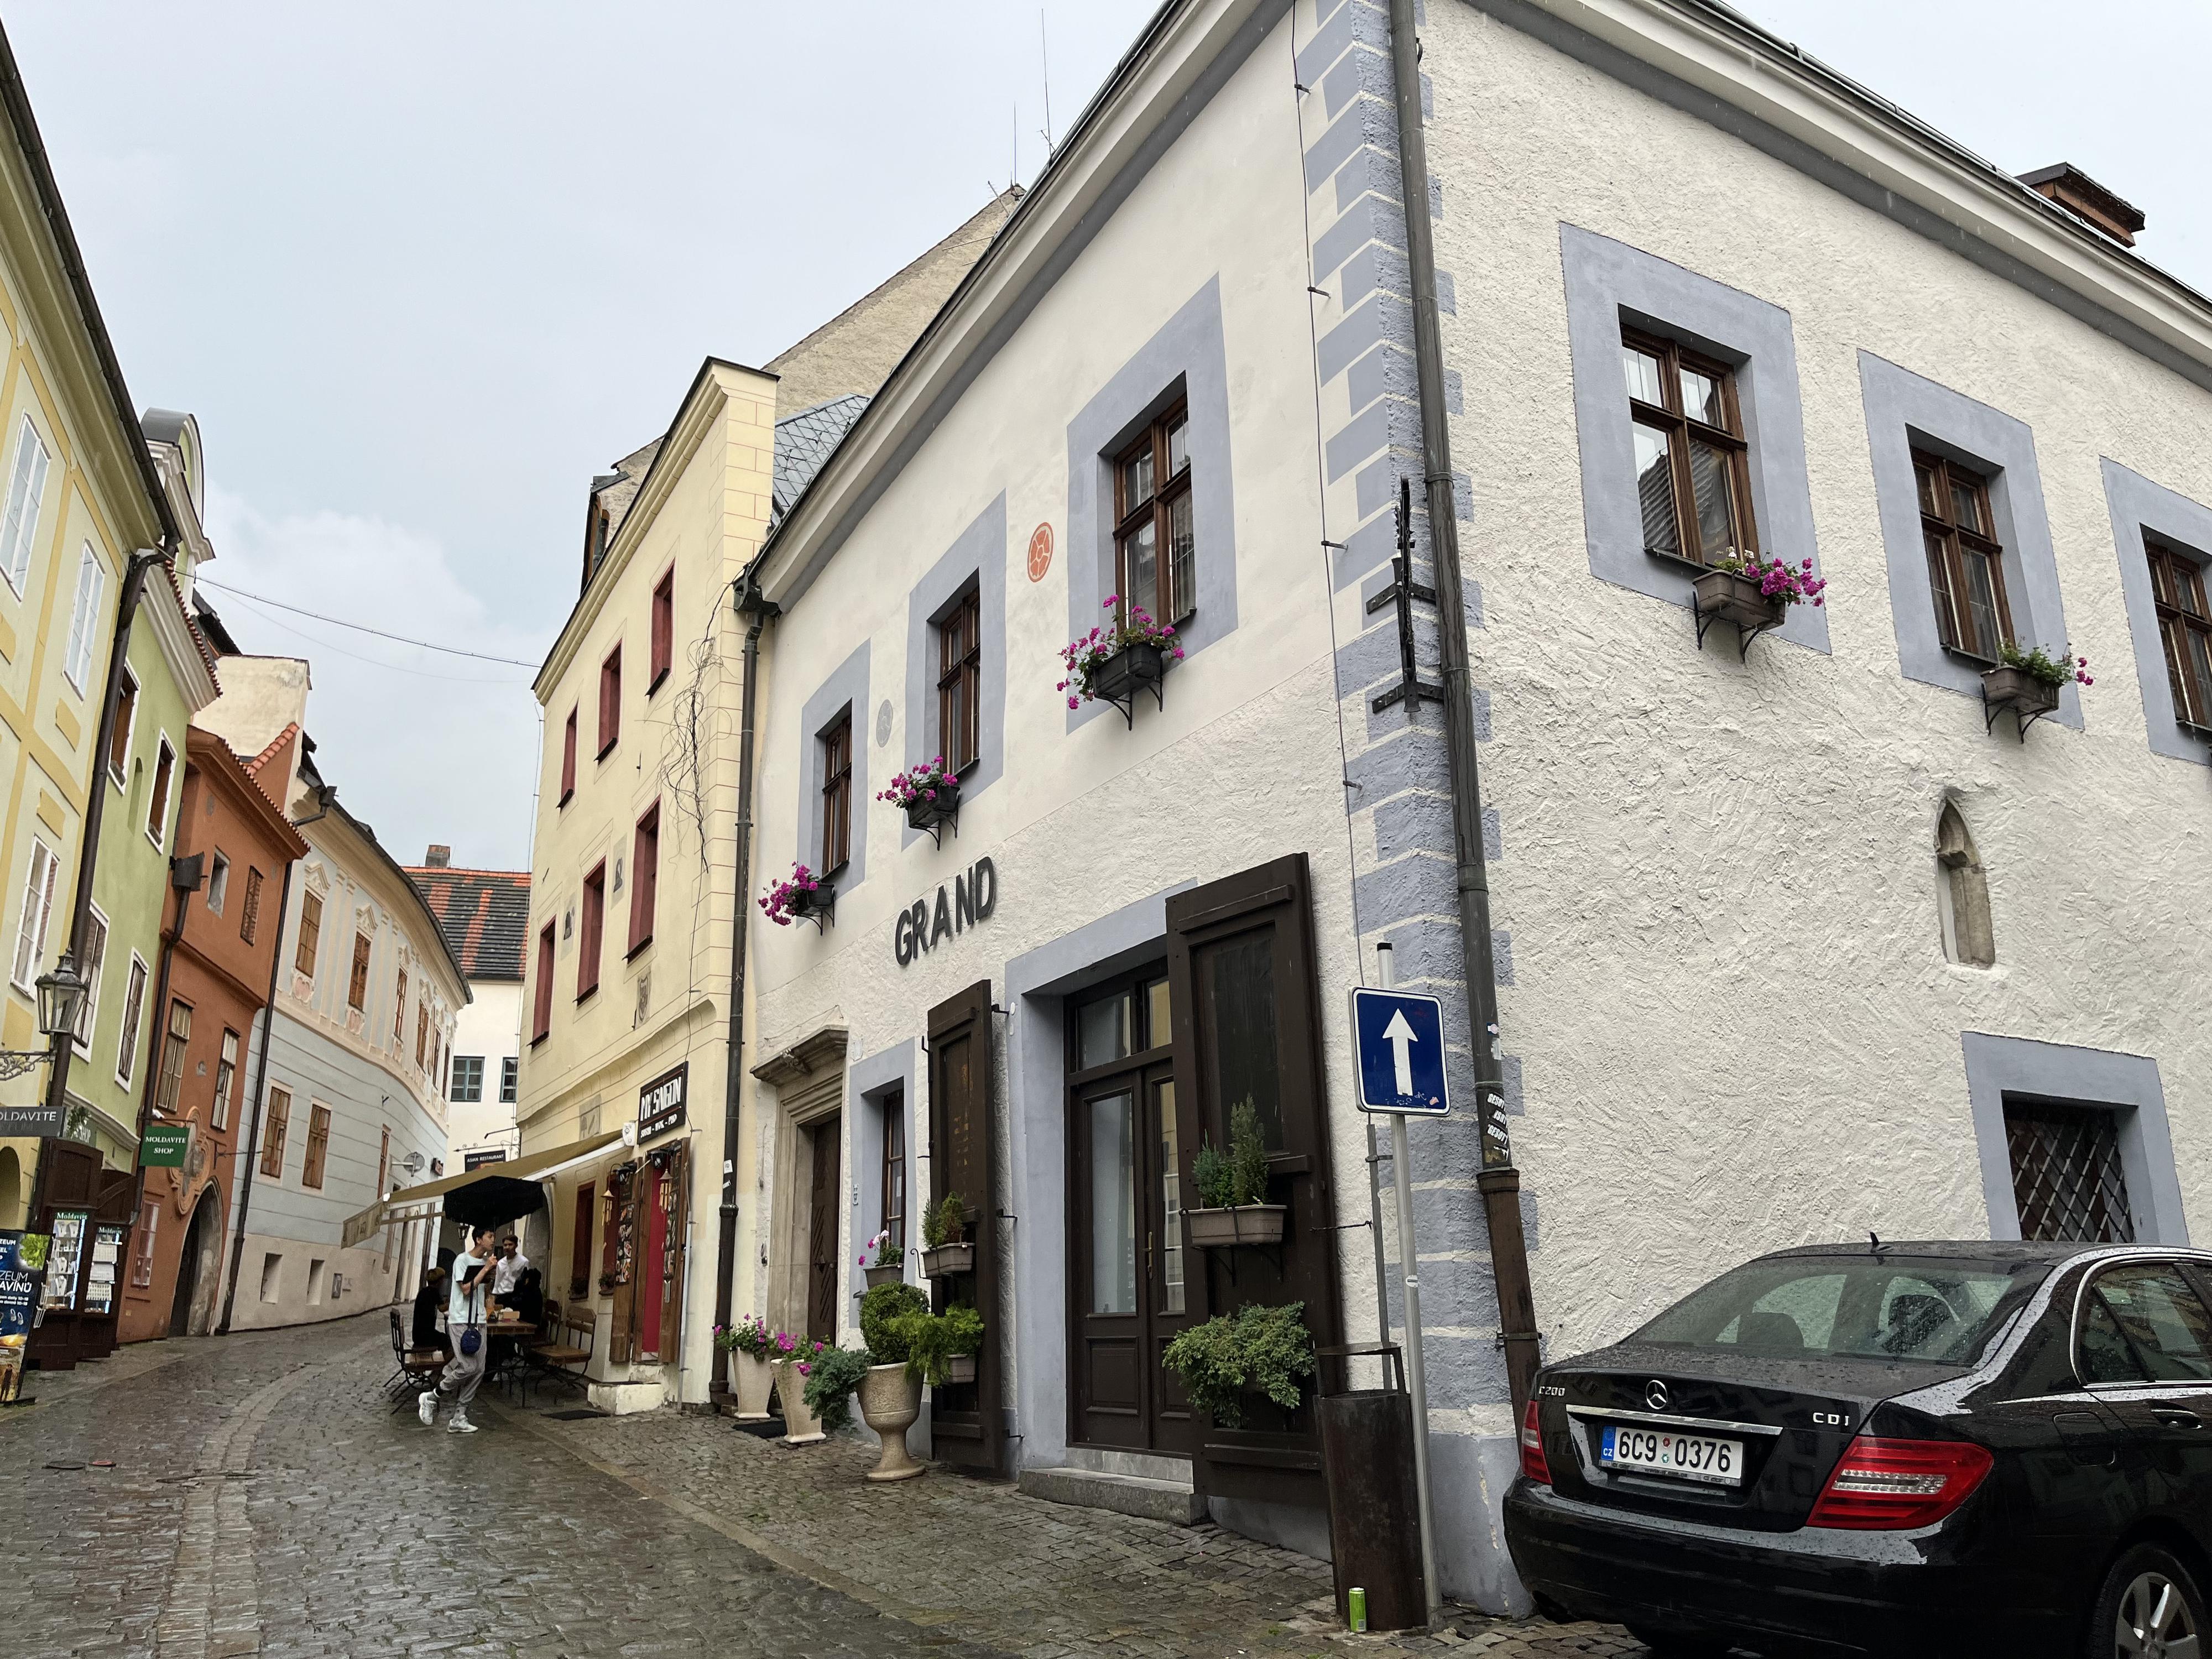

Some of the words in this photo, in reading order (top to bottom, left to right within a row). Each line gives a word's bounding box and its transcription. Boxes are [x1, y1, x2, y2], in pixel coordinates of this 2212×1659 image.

[895, 856, 994, 966] GRAND
[56, 1212, 88, 1220] Moldavite
[1813, 1412, 1849, 1426] CDI
[1603, 1448, 1613, 1457] CZ
[1619, 1431, 1657, 1462] 6C9
[1674, 1438, 1732, 1473] 0376
